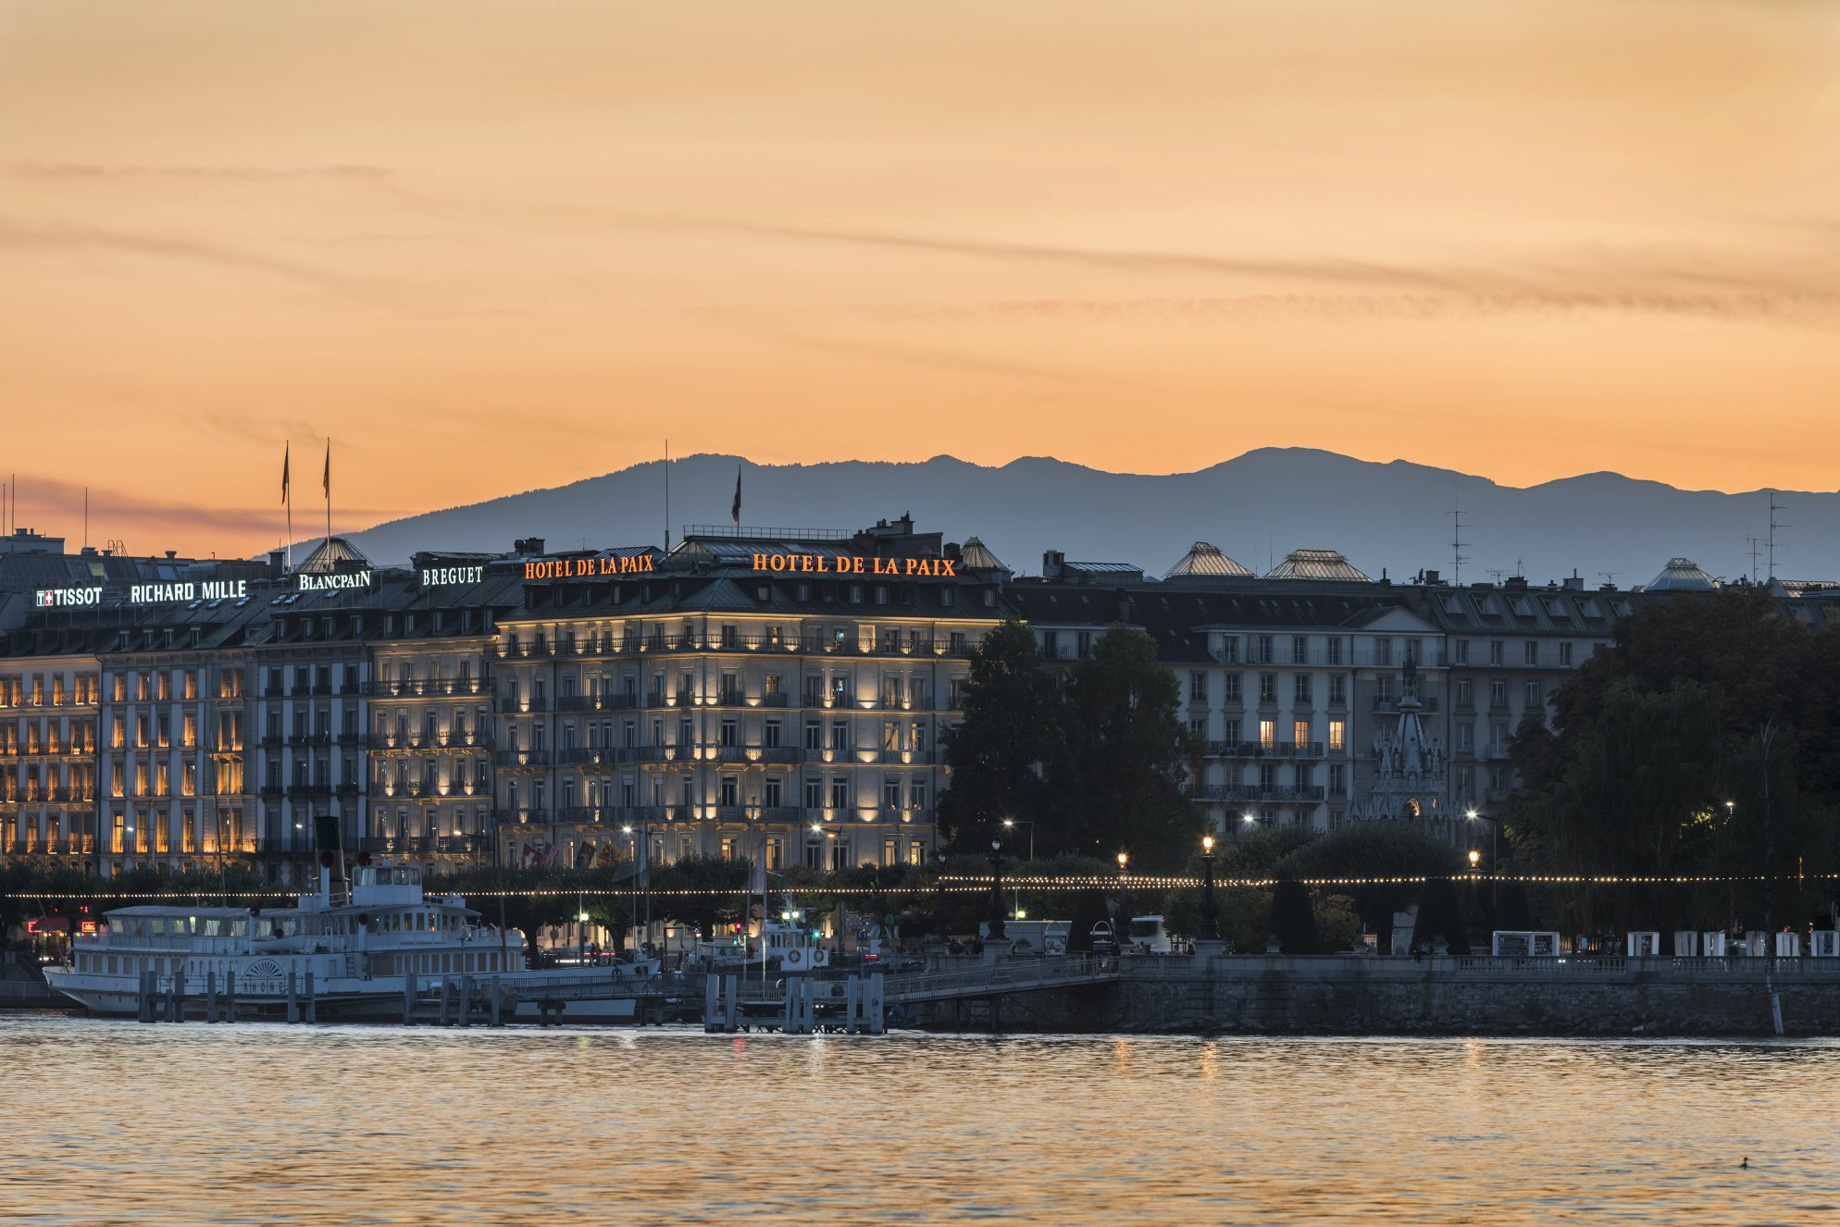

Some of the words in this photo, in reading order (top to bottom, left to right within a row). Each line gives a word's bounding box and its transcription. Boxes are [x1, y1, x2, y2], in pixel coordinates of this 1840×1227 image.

[422, 566, 483, 586] BREGUET
[525, 560, 573, 580] HOTEL
[576, 559, 596, 576] DE
[600, 557, 618, 575] LA
[620, 554, 653, 574] PAIX
[752, 553, 829, 573] HOTEL
[836, 556, 865, 574] DE
[873, 557, 900, 575] LA
[905, 558, 956, 577] PAIX
[131, 583, 194, 603] RICHARD
[202, 580, 246, 599] MILLE
[299, 570, 371, 591] BLANCPAIN
[54, 587, 102, 606] TISSOT
